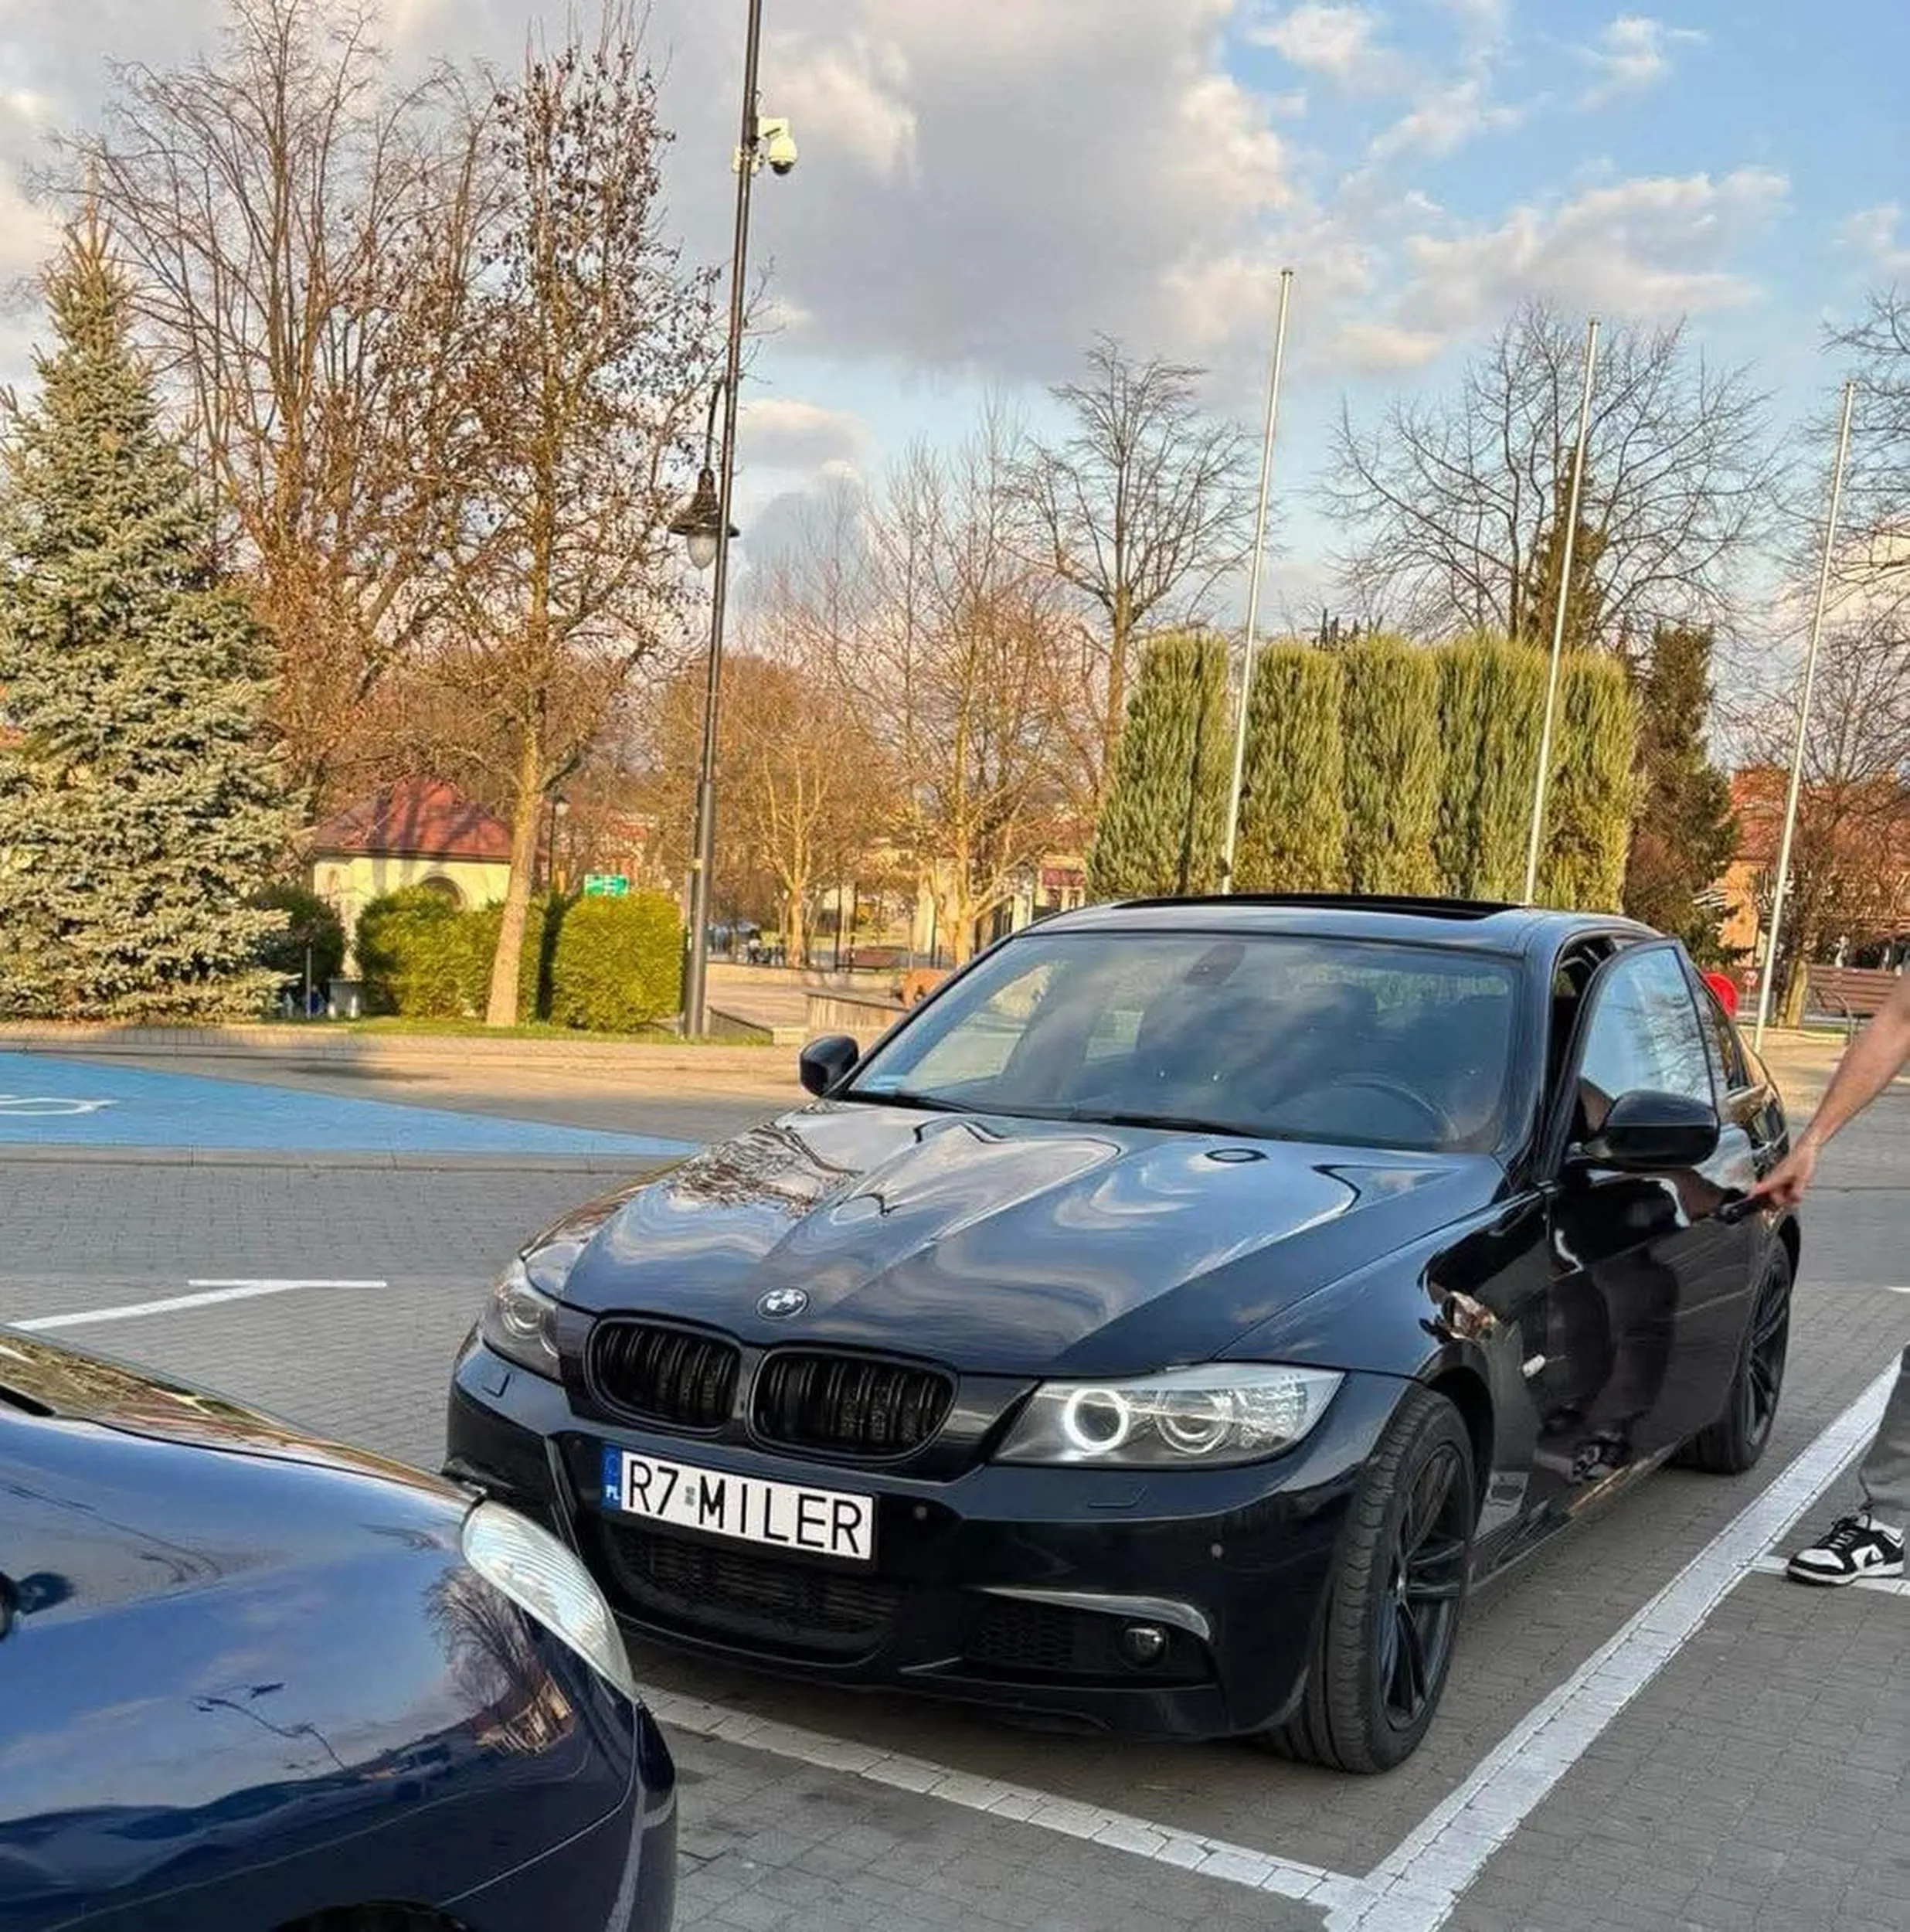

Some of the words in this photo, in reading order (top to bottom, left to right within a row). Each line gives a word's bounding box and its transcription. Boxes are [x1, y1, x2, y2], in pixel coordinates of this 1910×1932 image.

[606, 1485, 620, 1501] PL
[629, 1459, 679, 1516] R7
[698, 1475, 863, 1555] MILER
